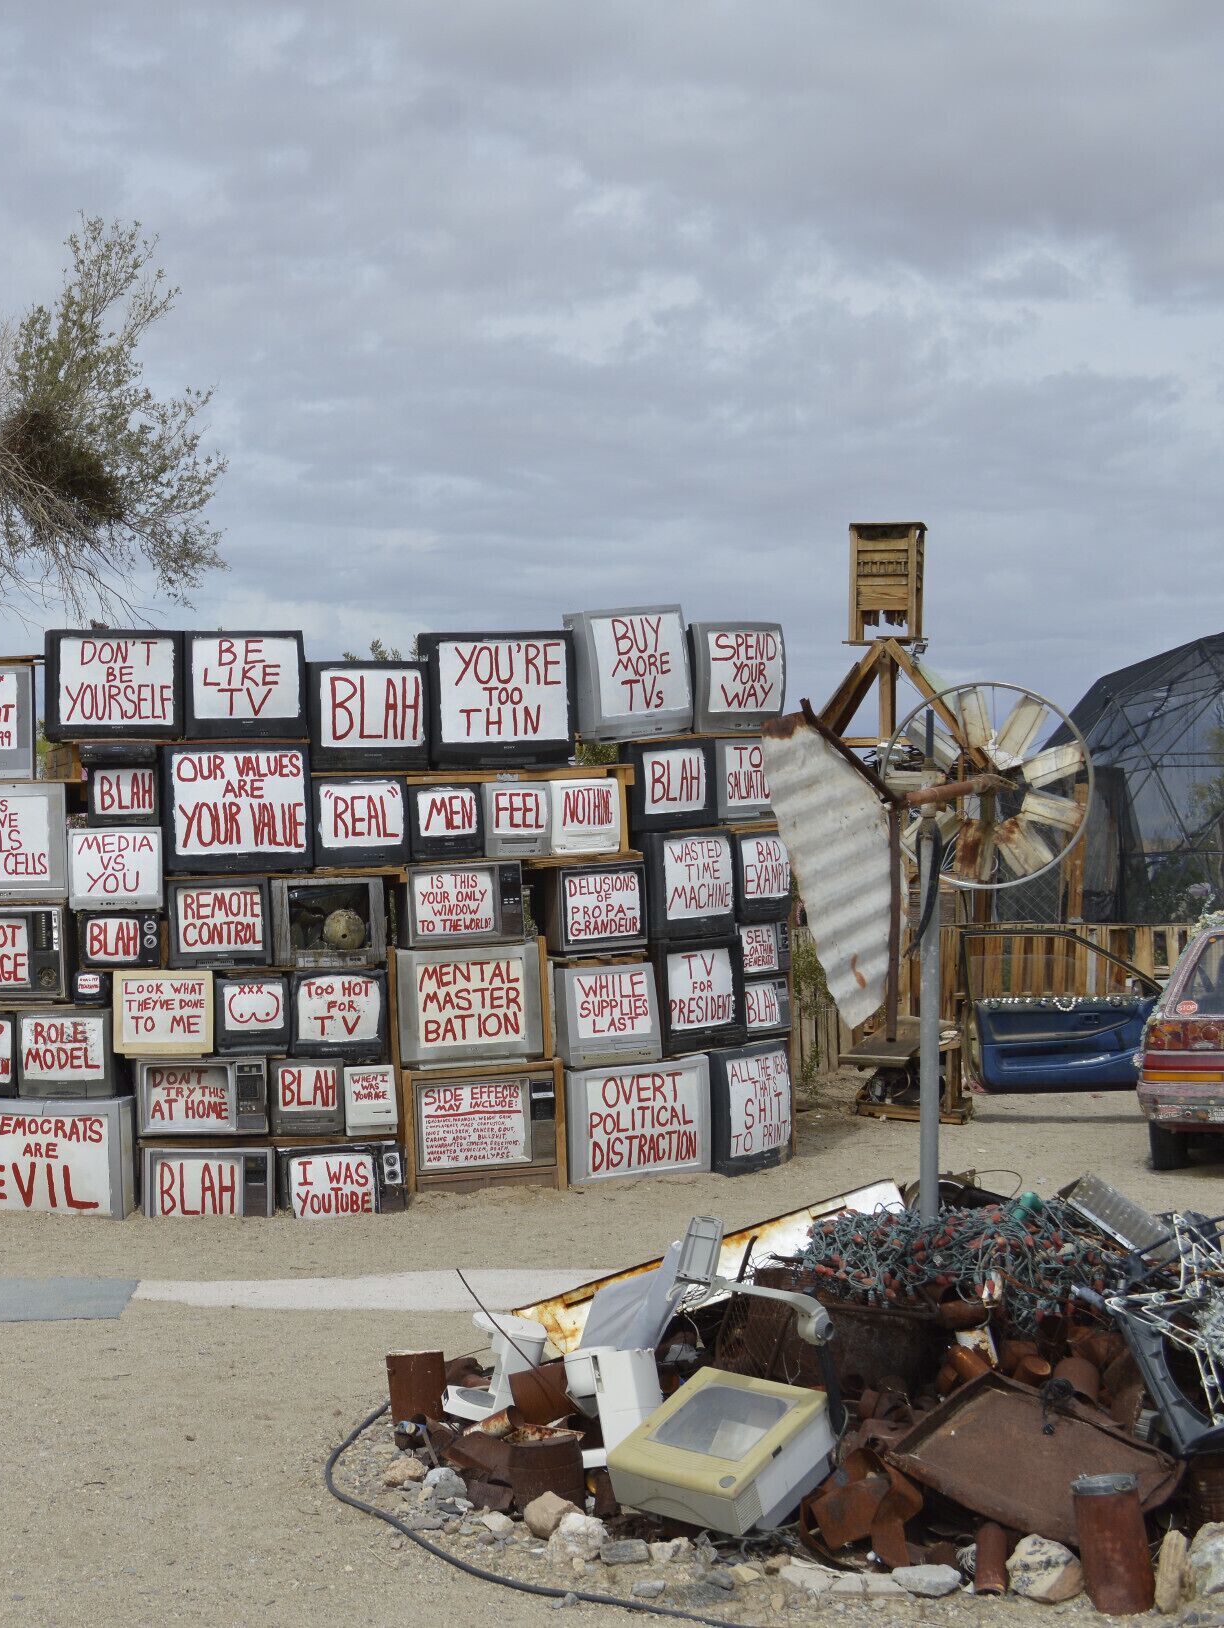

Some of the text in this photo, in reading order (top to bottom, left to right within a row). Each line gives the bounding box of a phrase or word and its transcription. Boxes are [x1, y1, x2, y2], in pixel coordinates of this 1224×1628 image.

[611, 616, 662, 656] BUY
[80, 640, 158, 666] DON'T
[218, 639, 265, 667] BE
[711, 633, 777, 662] SPEND
[106, 666, 133, 683] BE
[217, 687, 272, 716] TV
[483, 686, 523, 707] TOO
[721, 682, 774, 709] WAY
[99, 772, 153, 811] BLAH
[222, 778, 264, 799] ARE
[324, 786, 400, 839] "REAL"
[494, 792, 544, 829] FEEL
[77, 834, 153, 856] MEDIA
[668, 840, 722, 864] WASTED
[87, 872, 139, 894] YOU
[430, 874, 478, 889] IS THIS
[420, 888, 488, 905] YOUR ONLY
[596, 893, 612, 902] OF
[668, 881, 731, 911] MACHINE
[431, 903, 480, 917] WINDOW
[571, 903, 635, 919] PROPA-
[182, 920, 262, 947] CONTROL
[419, 917, 492, 933] TO THE WORLD?
[569, 917, 638, 937] GRANDEUR
[746, 929, 771, 945] SELF
[419, 960, 520, 992] MENTAL
[692, 980, 713, 994] FOR
[124, 982, 204, 996] LOOK WHAT
[237, 984, 264, 994] XXX
[341, 980, 373, 997] HOT
[128, 996, 205, 1012] THEY'VE DONE
[327, 1000, 357, 1013] FOR
[579, 997, 649, 1019] SUPPLIES
[670, 994, 732, 1025] PRESIDENT
[745, 987, 777, 1024] BLAH
[34, 1022, 88, 1044] ROLE
[425, 1011, 520, 1043] BATION
[352, 1074, 388, 1084] WHEN I
[731, 1057, 772, 1086] ALL THE
[162, 1086, 225, 1100] TRY THIS
[353, 1090, 373, 1102] YOUR
[361, 1083, 379, 1091] WAS
[424, 1084, 520, 1106] SIDE EFFECTS
[151, 1100, 228, 1120] AT HOME
[435, 1099, 518, 1112] MAY INCLUDE:
[745, 1092, 783, 1130] SHIT
[589, 1103, 693, 1139] POLITICAL
[22, 1142, 58, 1159] ARE
[159, 1161, 236, 1216] BLAH
[296, 1186, 373, 1218] YOUTUBE
